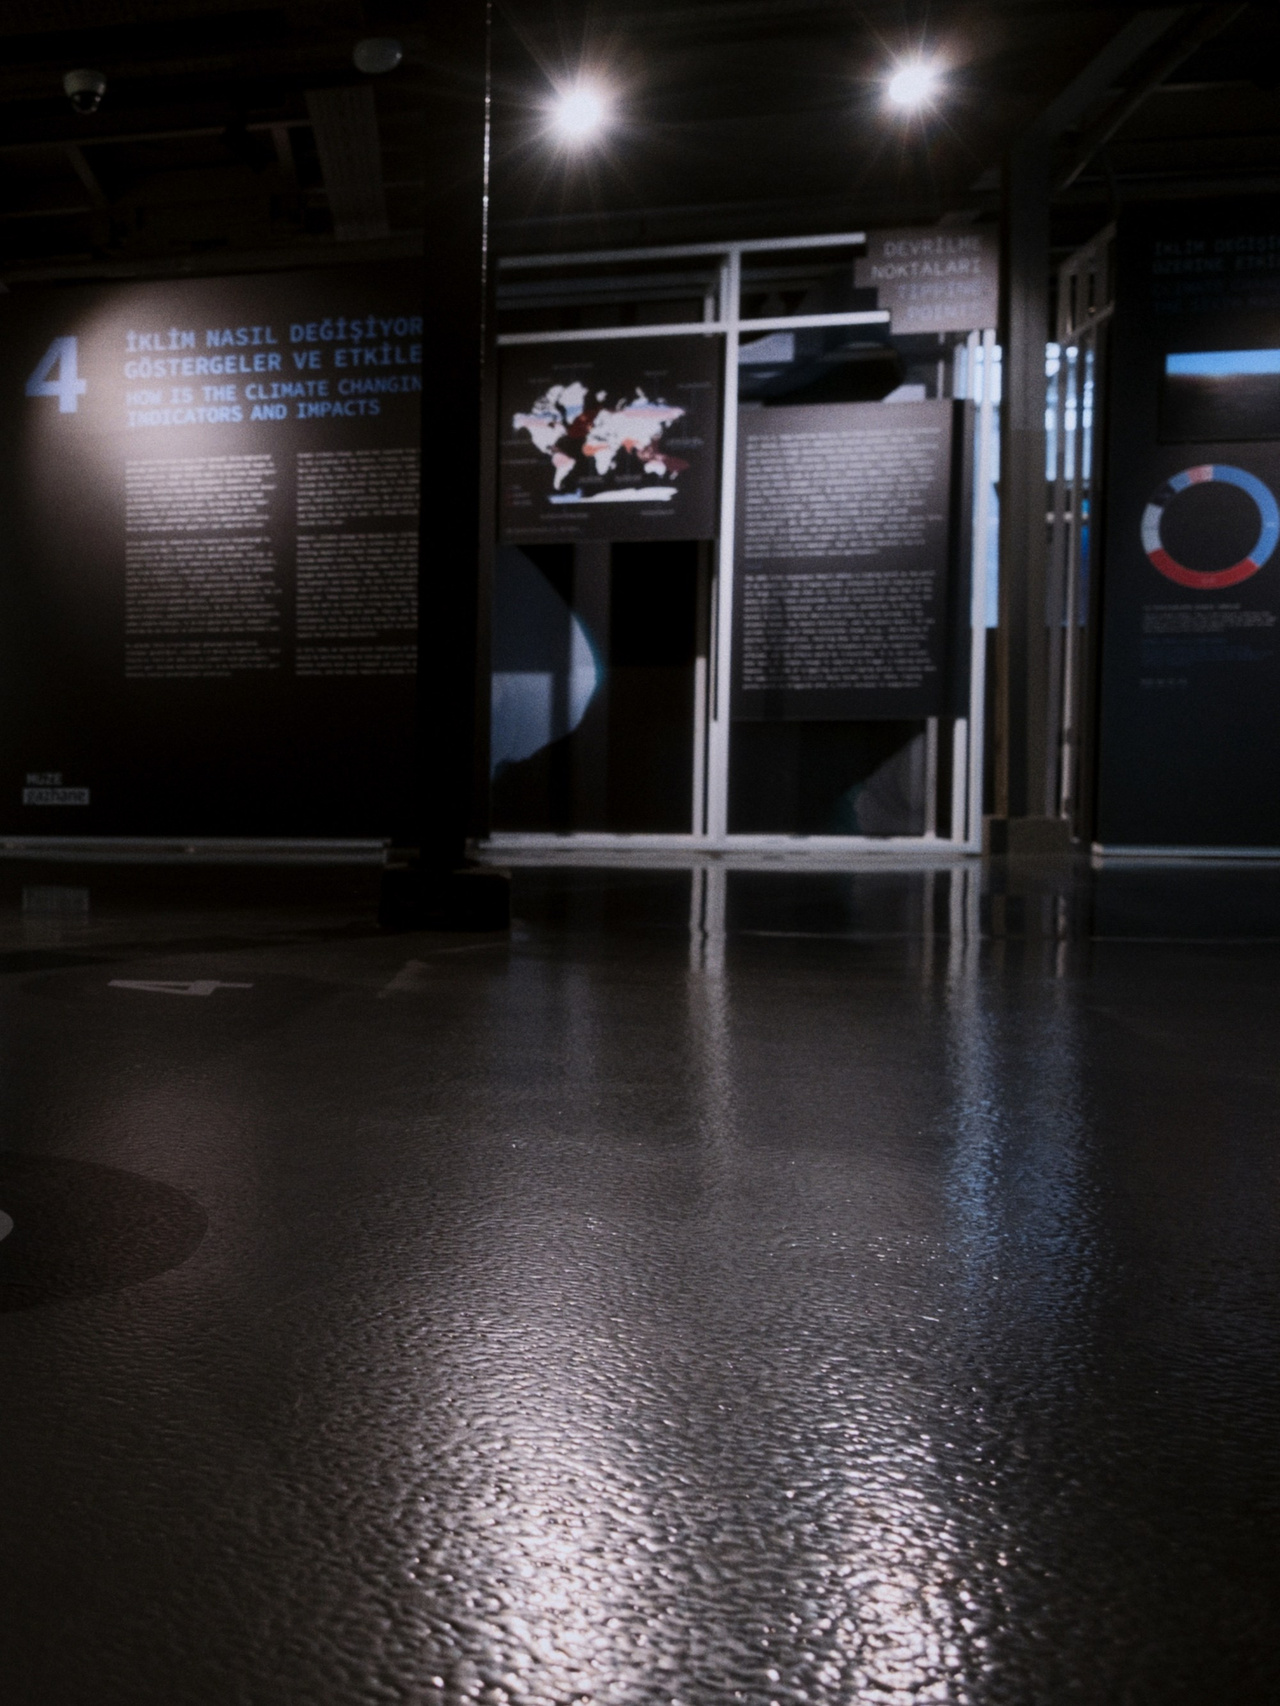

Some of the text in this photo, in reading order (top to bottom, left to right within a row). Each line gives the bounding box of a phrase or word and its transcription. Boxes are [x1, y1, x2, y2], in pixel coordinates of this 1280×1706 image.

[125, 313, 424, 352] İKLİM NASIL DEĞİŞİYOR
[25, 336, 87, 413] 4
[124, 351, 282, 379] GÖSTERGELER
[293, 350, 322, 370] VE
[126, 389, 163, 406] HOW
[170, 386, 194, 404] IS
[202, 383, 237, 403] THE
[245, 378, 330, 401] CLIMATE
[126, 396, 381, 428] INDICATORS AND IMPACTS
